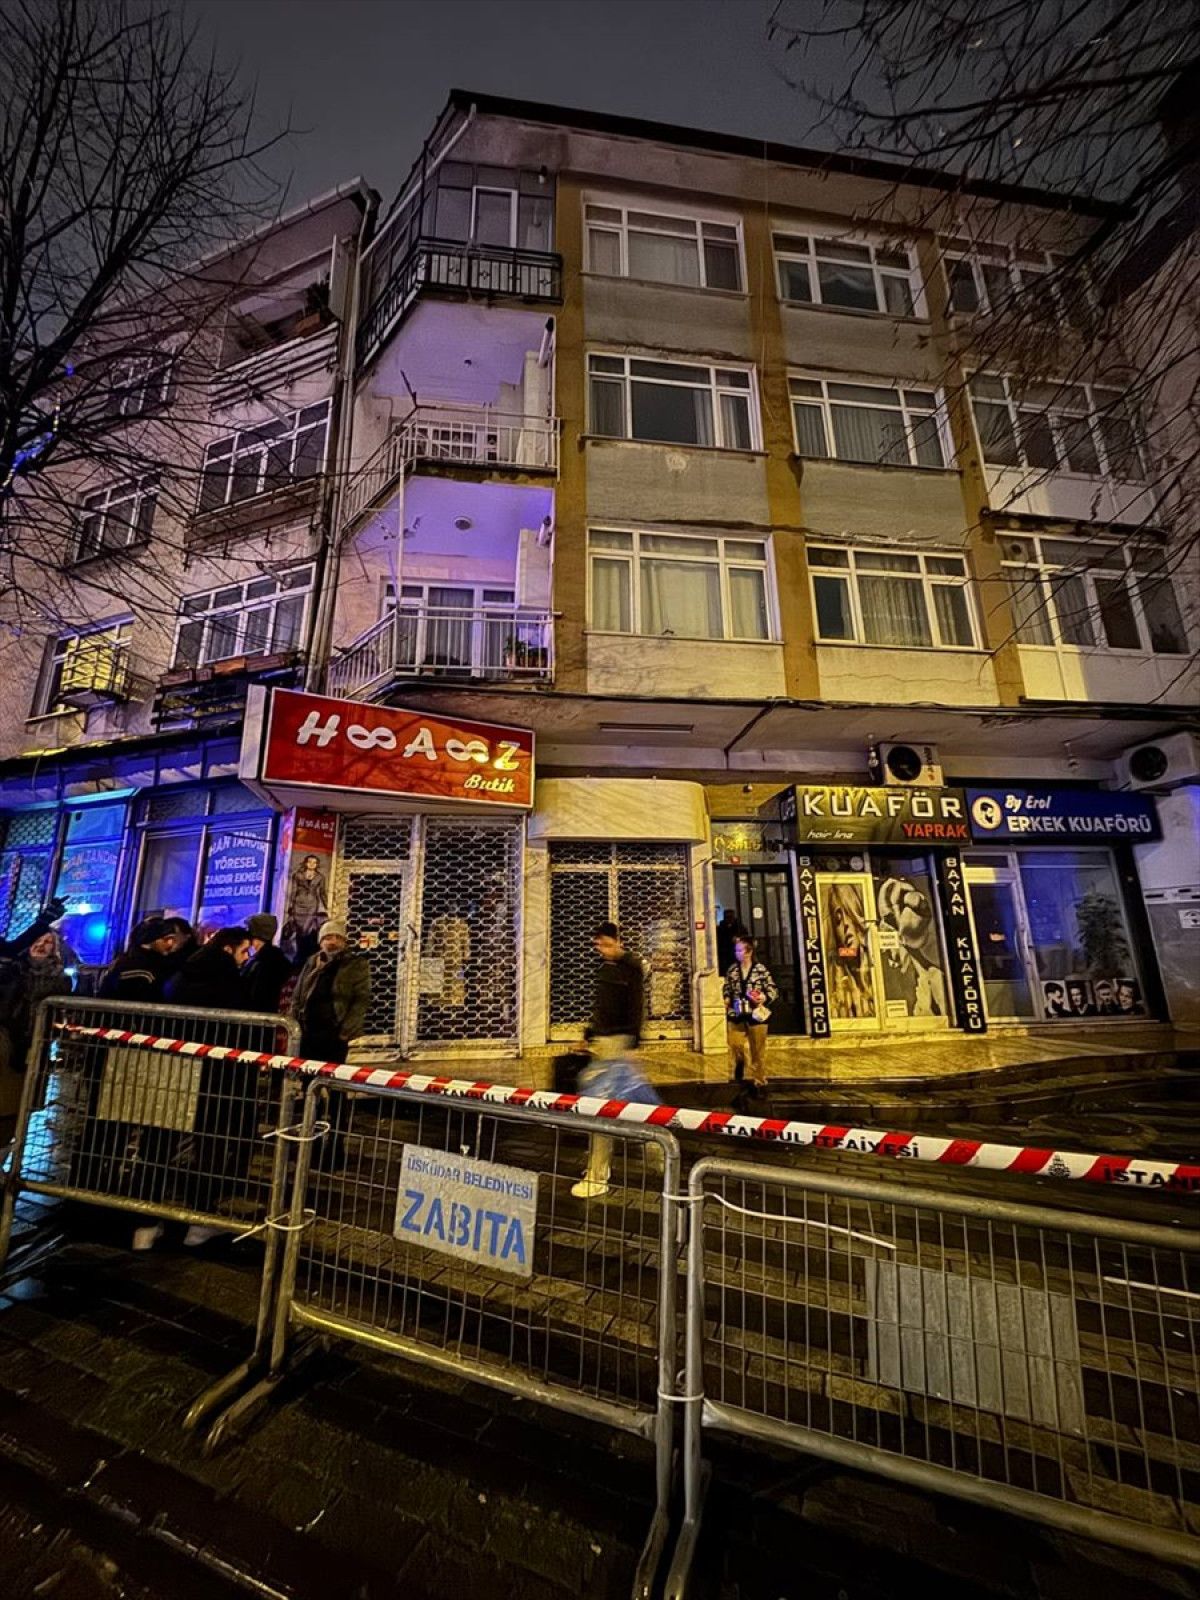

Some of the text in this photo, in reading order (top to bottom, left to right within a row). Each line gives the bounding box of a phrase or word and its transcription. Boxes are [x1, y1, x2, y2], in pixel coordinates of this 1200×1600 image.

[464, 774, 516, 792] Butik
[803, 792, 963, 818] KUAFÖR
[1005, 794, 1052, 812] By Erol
[903, 823, 968, 838] YAPRAK
[1007, 814, 1152, 833] ERKEK KUAFÖRÜ
[214, 856, 258, 870] YÖRESEL
[800, 856, 828, 1034] BAYAN KUAFÖRÜ
[946, 858, 982, 1029] BAYAN KUAFÖRÜ
[705, 1119, 919, 1158] İSTANBUL İTFAİYESİ
[407, 1154, 533, 1200] ÜSKÜDAR BELEDİYESİ
[401, 1189, 526, 1265] ZABITA
